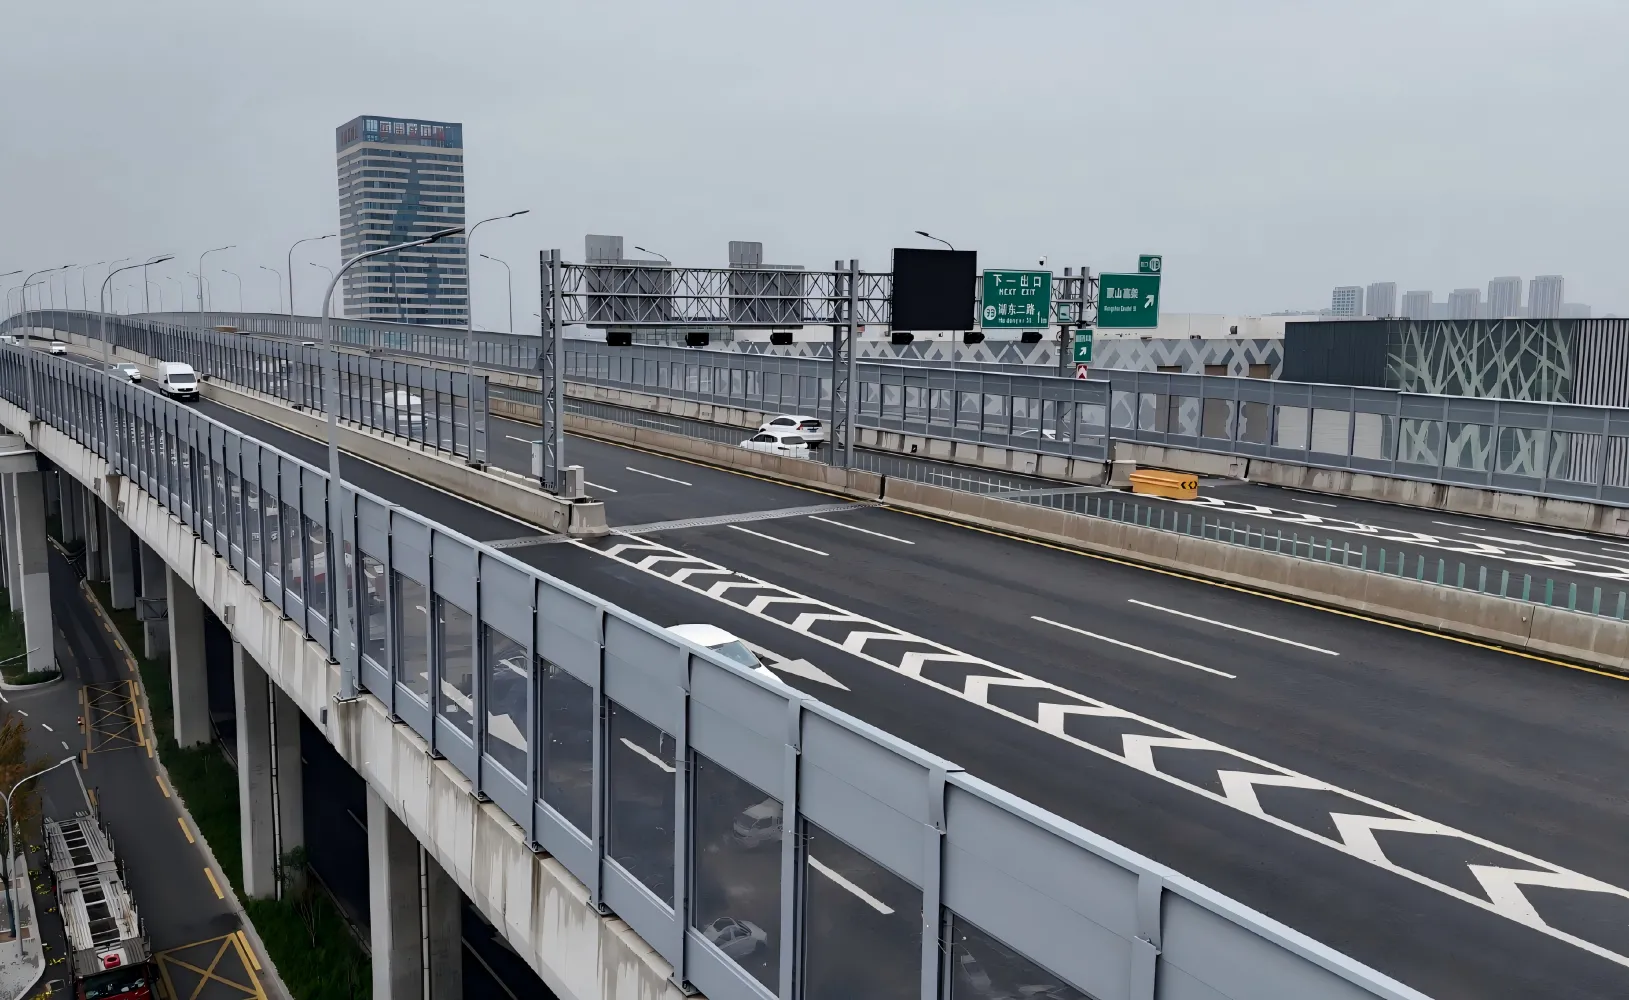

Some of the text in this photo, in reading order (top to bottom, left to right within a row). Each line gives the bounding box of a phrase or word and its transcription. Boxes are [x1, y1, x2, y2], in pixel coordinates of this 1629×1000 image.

[993, 274, 1041, 287] 下一出口
[998, 288, 1036, 296] NEXT EXIT
[998, 303, 1035, 316] 湖东二路
